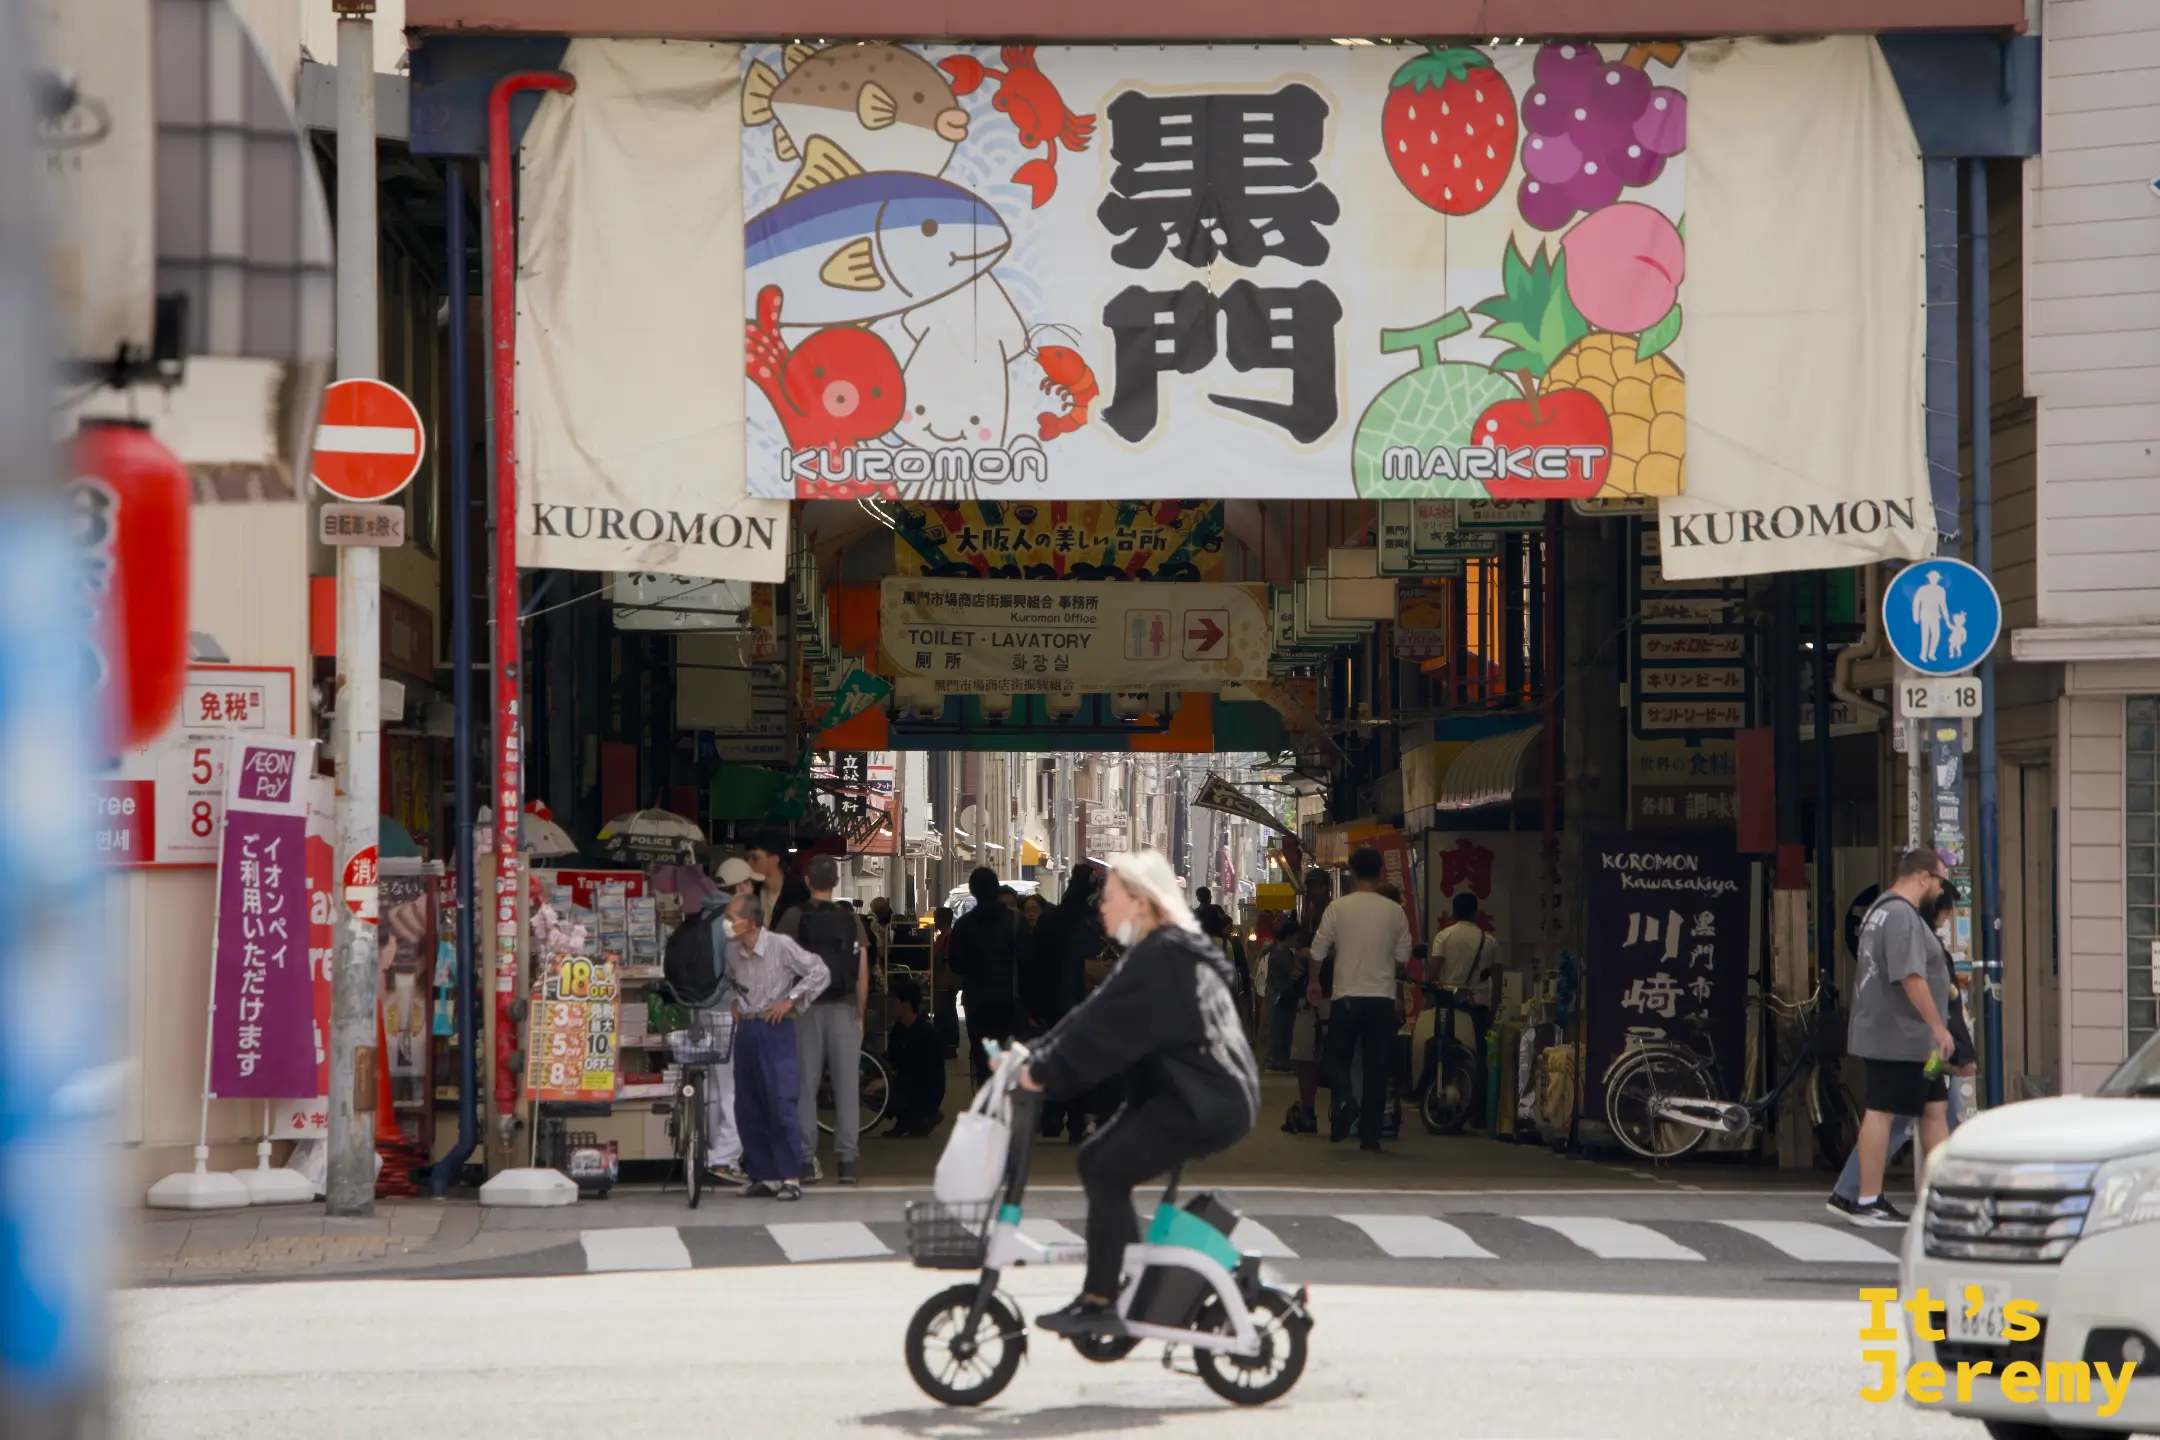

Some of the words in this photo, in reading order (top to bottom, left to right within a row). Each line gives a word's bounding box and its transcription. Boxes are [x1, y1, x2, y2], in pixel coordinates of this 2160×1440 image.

[1096, 82, 1343, 445] 黒門
[780, 446, 1048, 483] KUROMON
[1382, 444, 1606, 482] MARKET
[532, 503, 777, 550] KUROMON
[1670, 497, 1917, 549] KUROMON
[956, 525, 1168, 554] 大阪人の美しい台所
[1010, 612, 1061, 624] Kuromon
[908, 629, 975, 648] TOILET
[992, 632, 1092, 650] LAVATORY
[1646, 638, 1741, 654] サッポロビール
[1011, 653, 1070, 672] 화장실
[1646, 673, 1741, 688] キリンビール
[200, 691, 248, 722] 免税
[1906, 688, 1929, 709] 12
[1954, 686, 1977, 708] 18
[1646, 706, 1741, 724] サントリービール
[192, 748, 212, 784] 5
[257, 777, 287, 798] Pay
[191, 801, 213, 837] 8
[630, 835, 672, 846] POLICE
[1621, 872, 1739, 898] Kawasakiya
[237, 834, 266, 1078] ご利用いただけます
